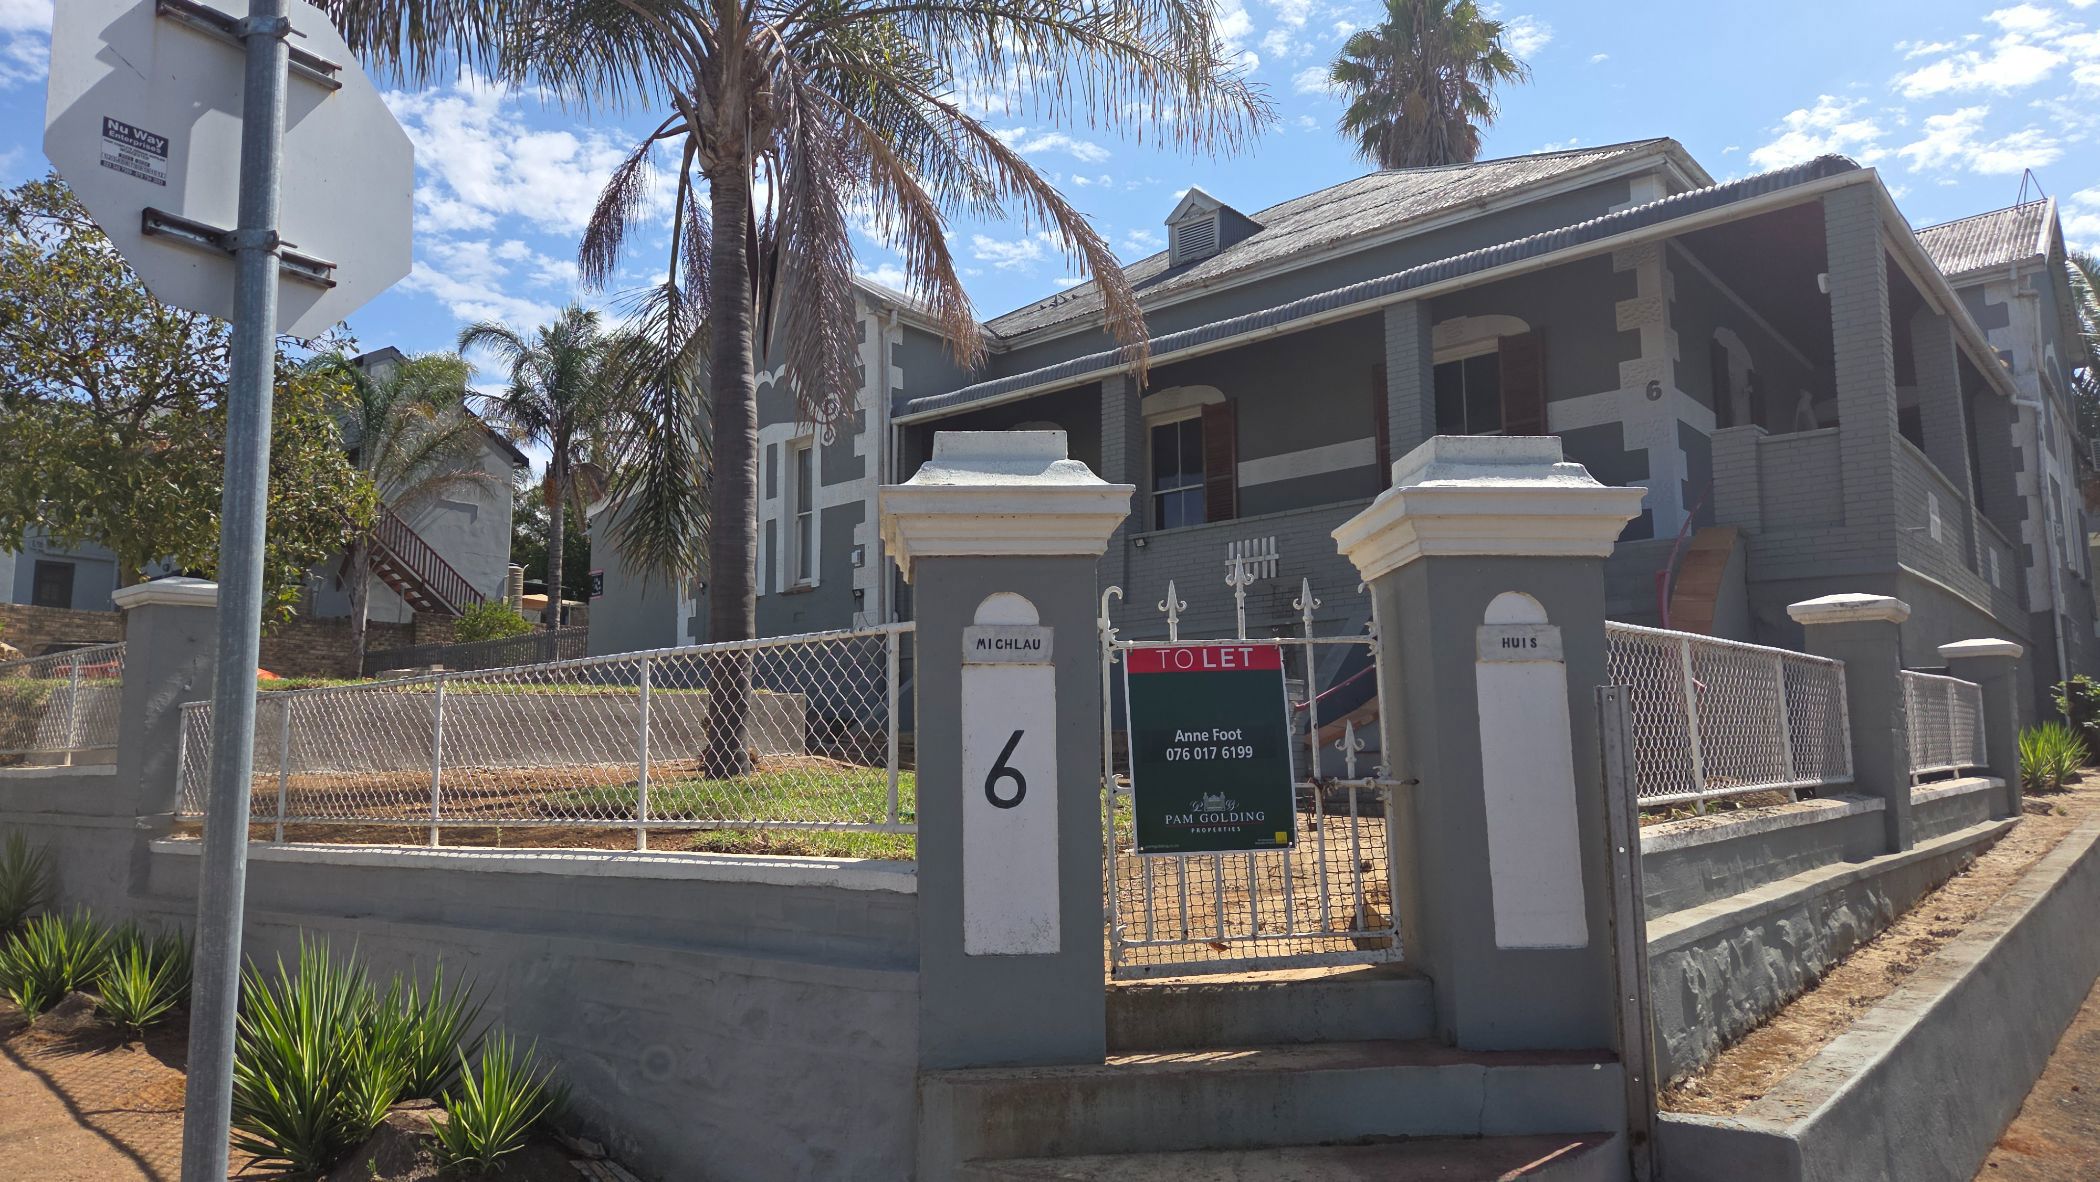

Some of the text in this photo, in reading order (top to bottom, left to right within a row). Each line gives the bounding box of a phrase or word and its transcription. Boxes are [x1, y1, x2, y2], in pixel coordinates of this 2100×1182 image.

[108, 119, 165, 149] Nu Way
[109, 130, 162, 154] Enterprises
[1646, 379, 1662, 402] 6
[976, 637, 1041, 651] MICHLAU
[1502, 637, 1537, 649] HUIS
[1156, 647, 1254, 669] TO LET
[1174, 728, 1243, 743] Anne Foot
[1166, 745, 1253, 761] 076 017 6199
[984, 729, 1027, 810] 6
[1165, 811, 1265, 825] PAM GOLDING
[1191, 826, 1241, 834] PROPERTIES
